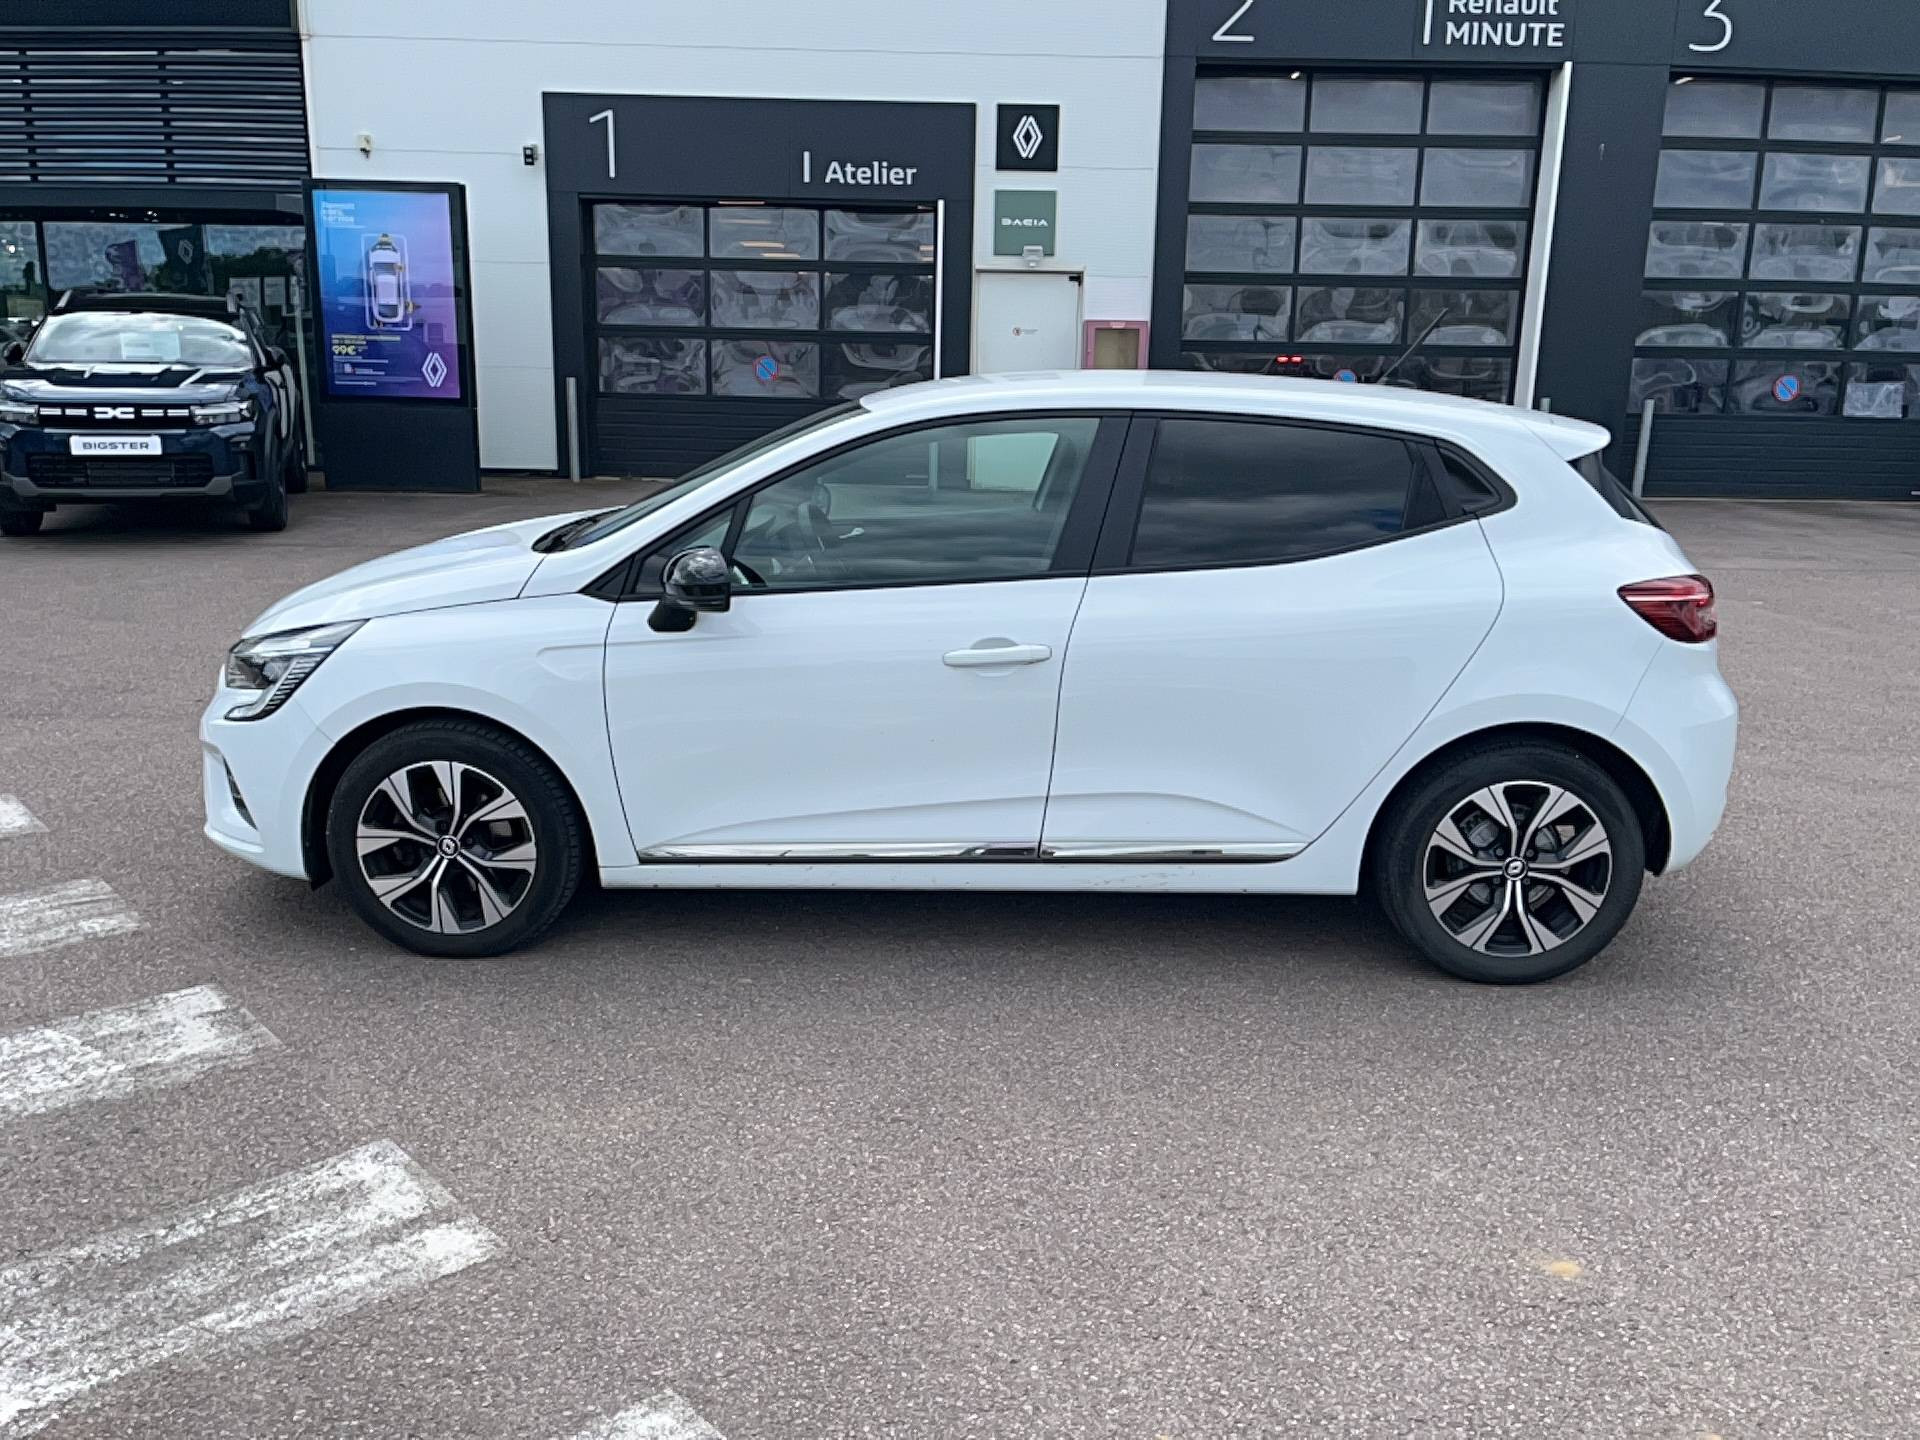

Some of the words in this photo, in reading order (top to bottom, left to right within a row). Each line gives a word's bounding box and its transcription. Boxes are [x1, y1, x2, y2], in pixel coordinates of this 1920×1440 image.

[1445, 21, 1566, 46] MINUTE
[1688, 0, 1732, 51] 3
[588, 108, 616, 178] 1
[824, 161, 917, 185] Atelier
[1001, 218, 1049, 226] DACIA
[82, 442, 149, 450] BIGSTER
